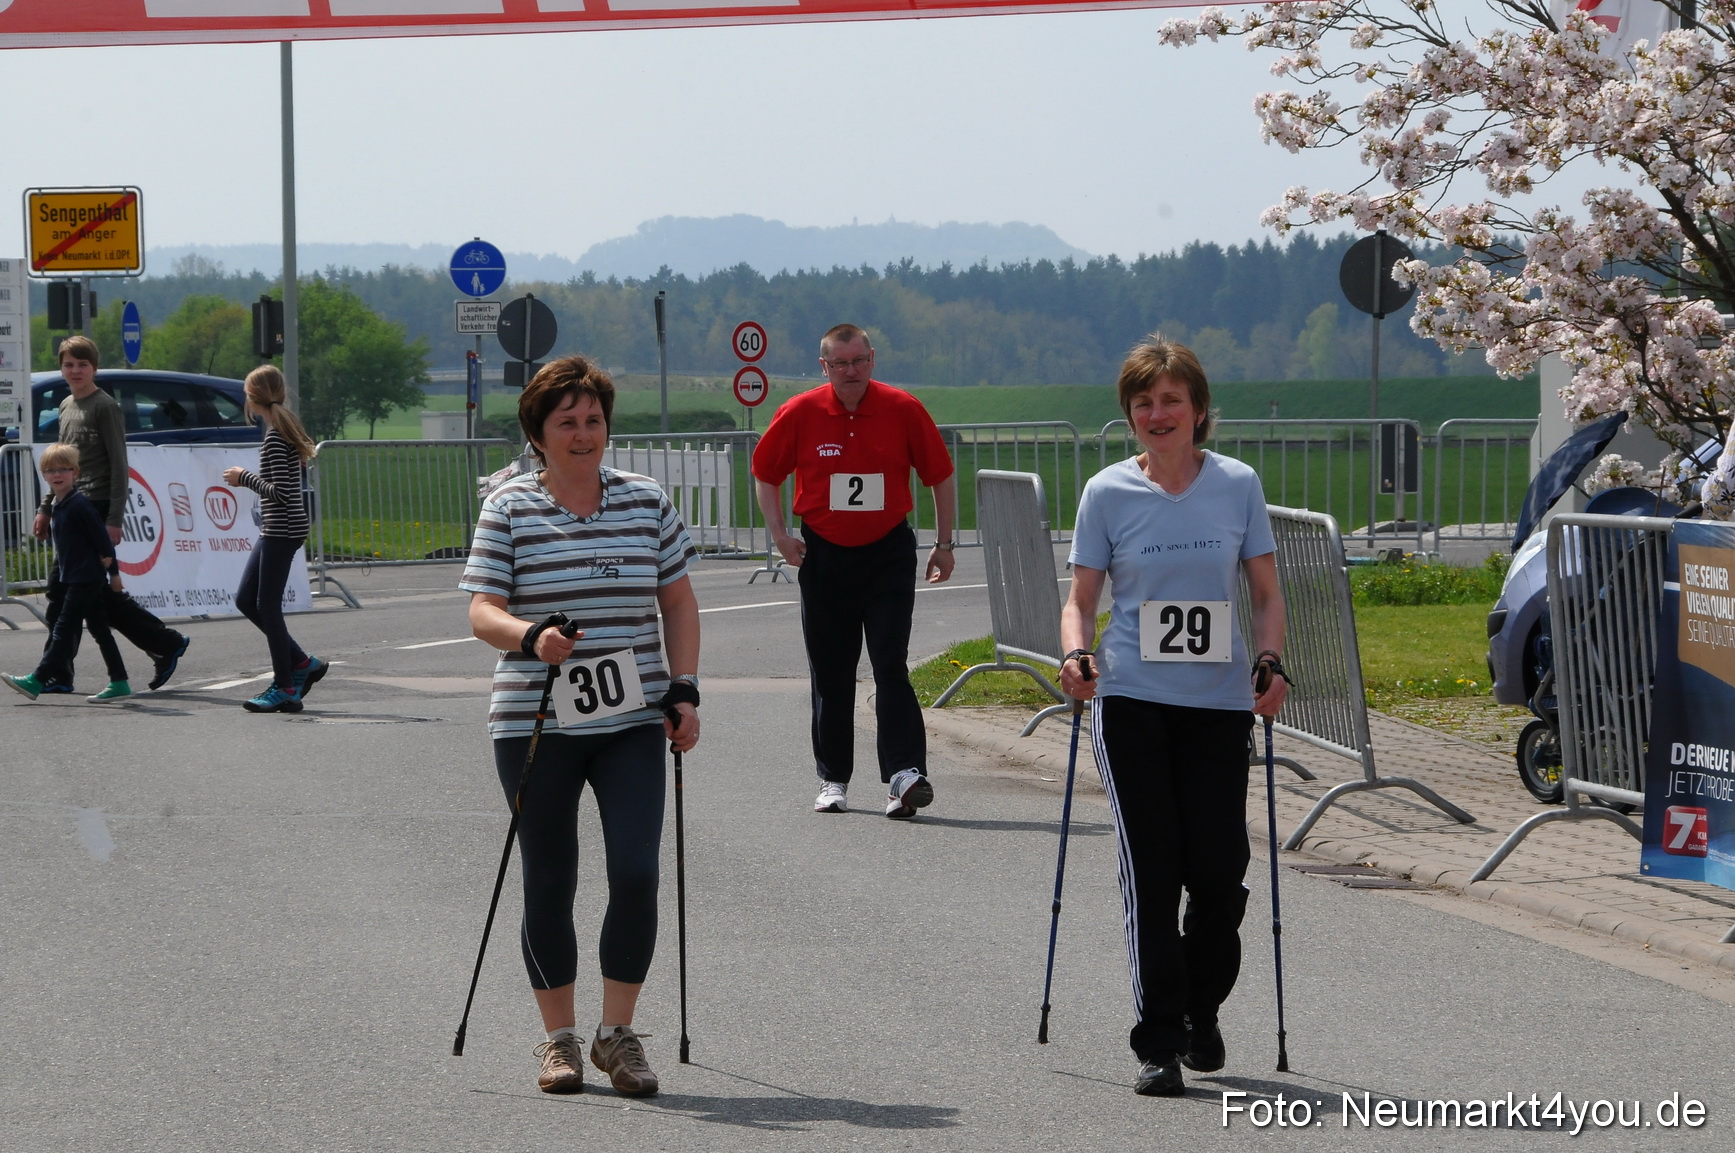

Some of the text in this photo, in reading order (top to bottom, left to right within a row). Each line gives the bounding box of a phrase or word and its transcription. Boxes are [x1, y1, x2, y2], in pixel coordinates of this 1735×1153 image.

[40, 202, 128, 227] Sengenthal
[52, 228, 117, 242] am Anger
[62, 250, 102, 261] Neumarkt
[460, 314, 498, 322] schaftlicher
[463, 305, 494, 313] Landwirt-
[460, 323, 497, 331] Verkehr fre
[740, 332, 760, 352] 60
[819, 449, 841, 457] RBA
[125, 487, 135, 514] T
[847, 475, 864, 506] 2
[208, 497, 232, 520] KIA
[122, 515, 155, 542] NIG
[174, 539, 202, 552] SEAT
[221, 537, 252, 552] MOTORS
[1140, 540, 1222, 555] JOY SINCE 1977
[1700, 565, 1729, 591] SEINER
[169, 589, 185, 607] Tel.
[1159, 605, 1211, 656] 29
[1687, 618, 1709, 644] SEINE
[568, 658, 625, 715] 30
[1670, 742, 1704, 767] DER
[1704, 745, 1730, 773] NEUE
[1668, 811, 1698, 850] 7
